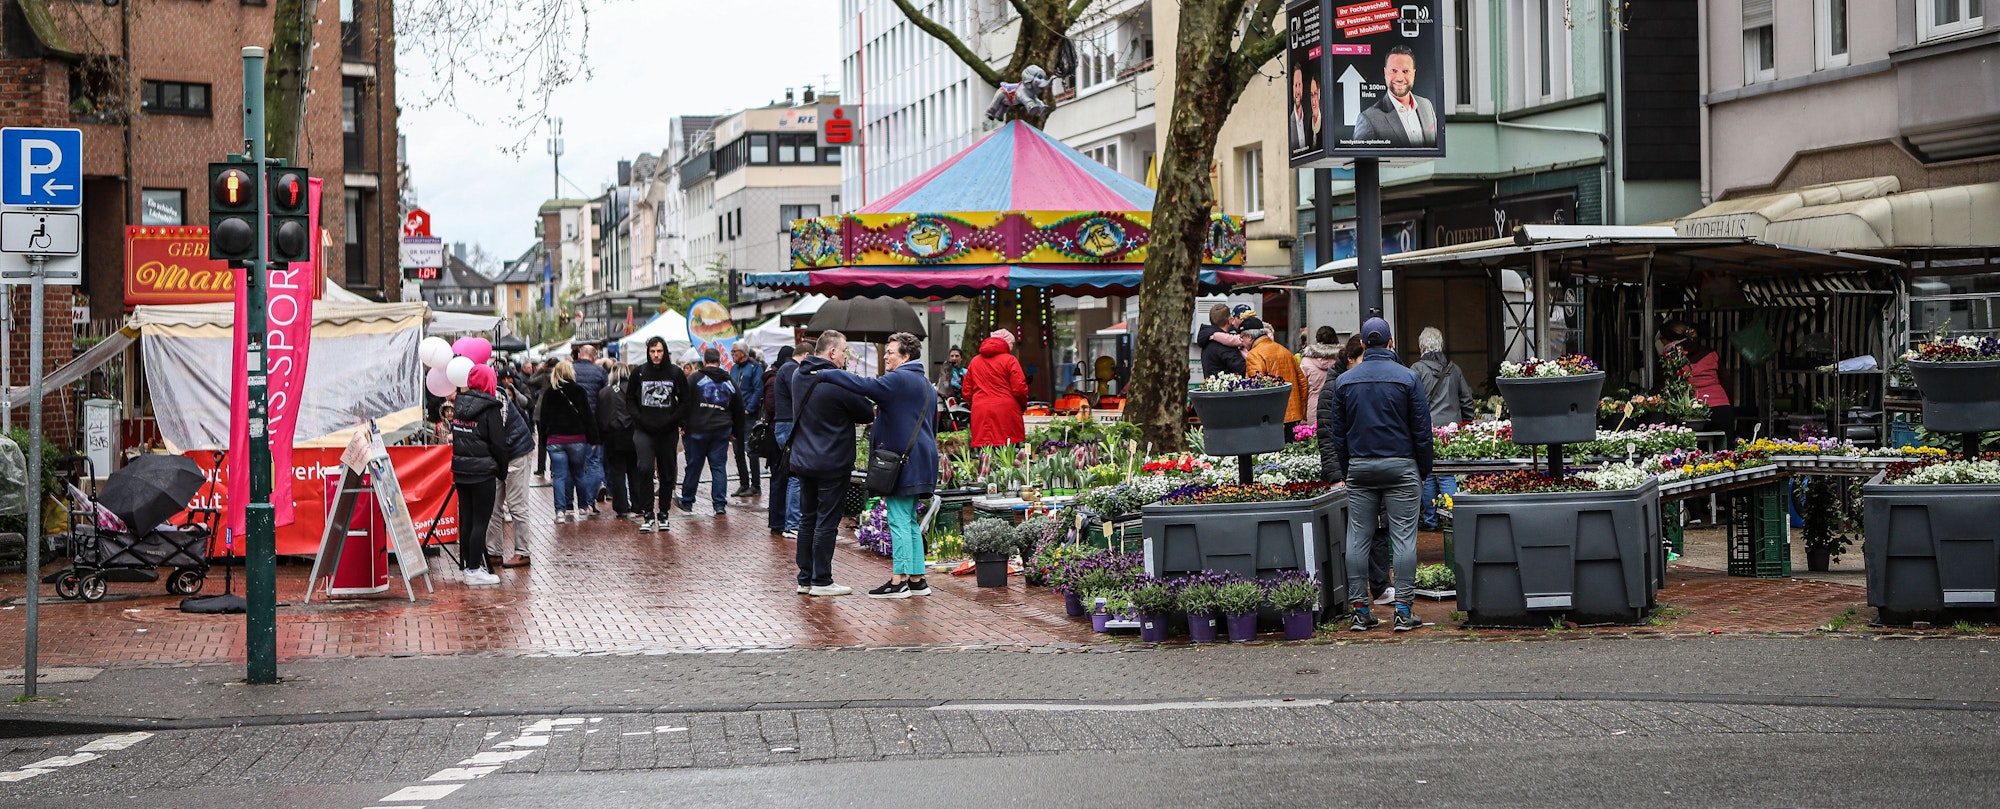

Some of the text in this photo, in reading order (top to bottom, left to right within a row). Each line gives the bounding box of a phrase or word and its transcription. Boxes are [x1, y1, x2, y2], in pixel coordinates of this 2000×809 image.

[1349, 1, 1389, 13] Fachgeschäft
[1346, 15, 1373, 24] Festnetz,
[1373, 10, 1398, 20] Internet
[1346, 22, 1390, 36] und Mobilfunk
[21, 139, 63, 196] P
[136, 261, 236, 291] Man
[201, 468, 223, 483] ut
